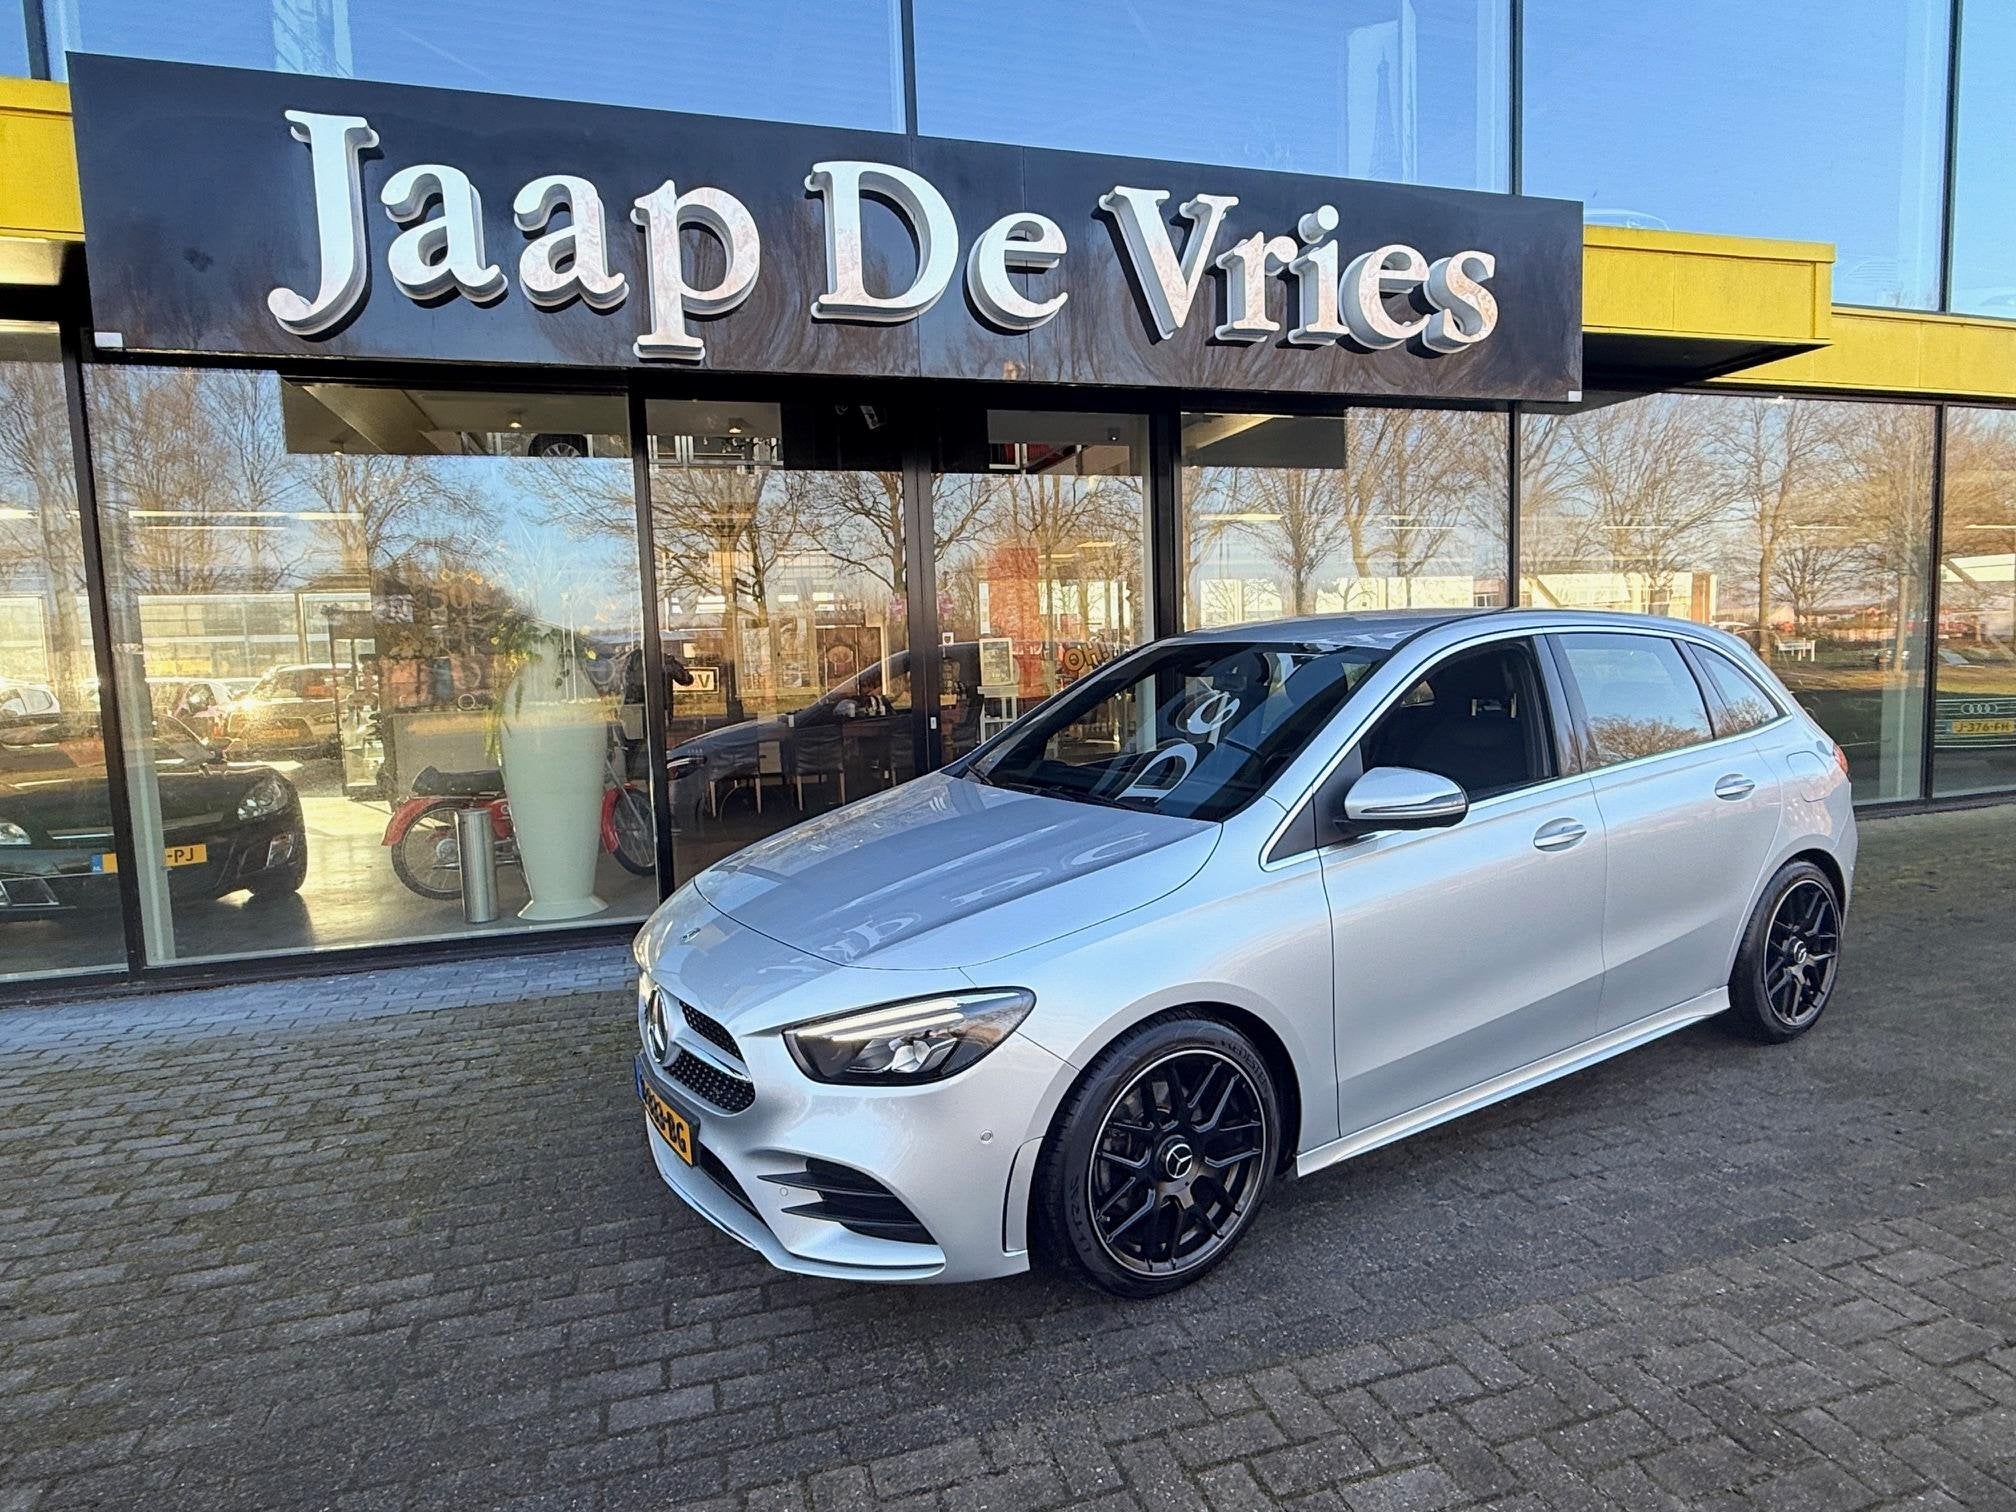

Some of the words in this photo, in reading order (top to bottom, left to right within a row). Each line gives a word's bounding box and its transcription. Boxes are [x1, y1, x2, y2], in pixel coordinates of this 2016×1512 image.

[267, 109, 761, 362] Jaap
[804, 160, 1069, 331] De
[1098, 184, 1499, 354] Vries
